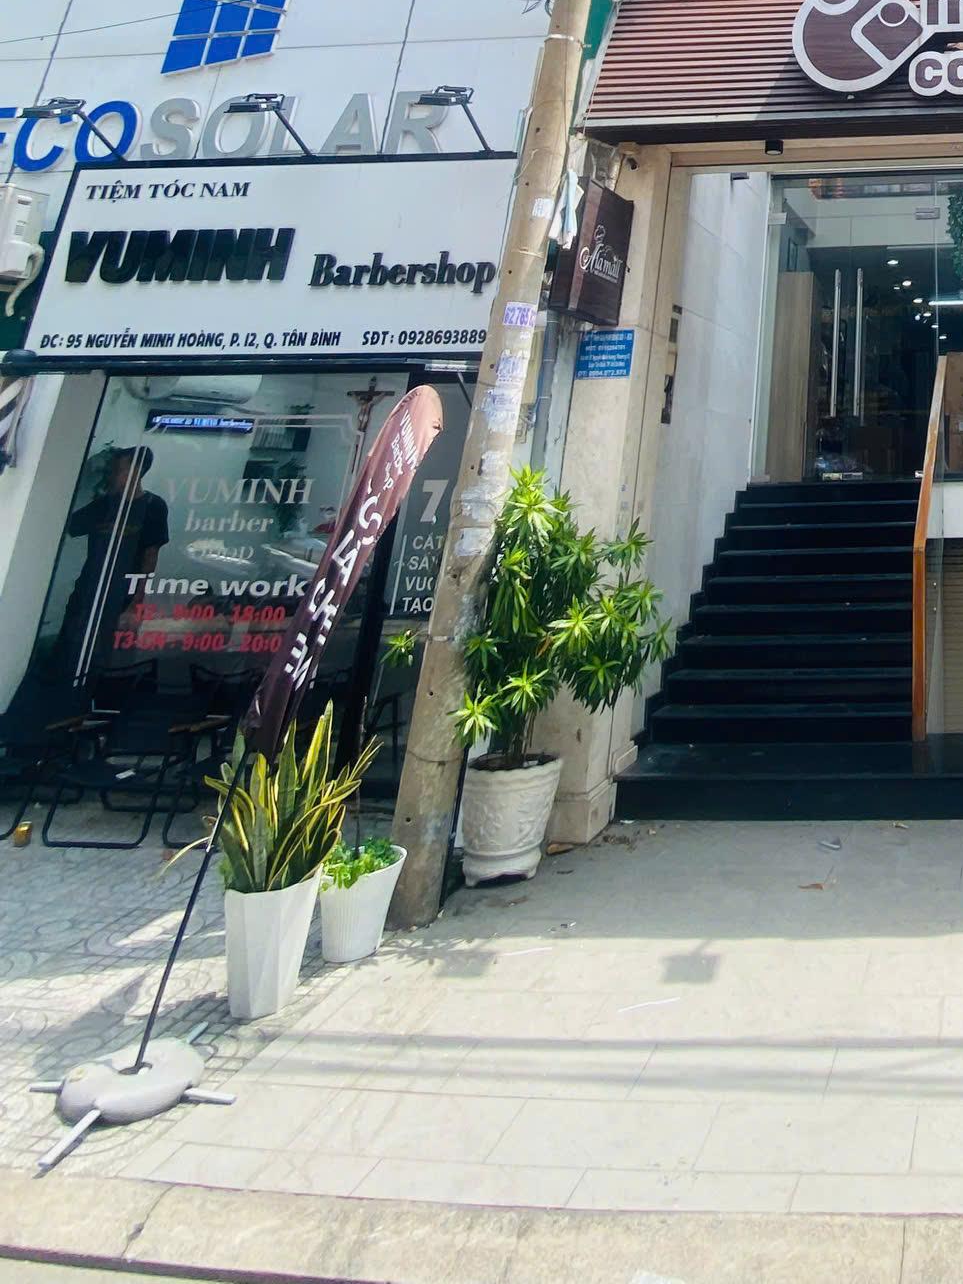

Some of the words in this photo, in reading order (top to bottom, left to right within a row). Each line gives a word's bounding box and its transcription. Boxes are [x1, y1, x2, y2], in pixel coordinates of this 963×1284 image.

[86, 180, 142, 203] TIỆM
[149, 179, 195, 199] TÓC
[200, 182, 251, 198] NAM
[64, 227, 296, 284] VUMINH
[308, 250, 496, 293] Barbershop
[66, 333, 82, 348] 95
[85, 327, 138, 348] NGUYỄN
[140, 333, 175, 348] MINH
[177, 329, 226, 350] HOÀNG,
[229, 332, 240, 347] P.
[263, 332, 278, 348] Q.
[282, 328, 307, 347] TÂN
[310, 328, 342, 347] BÌNH
[399, 329, 487, 346] 0928693889
[184, 508, 275, 533] barber
[125, 572, 209, 596] Time
[219, 574, 310, 597] work
